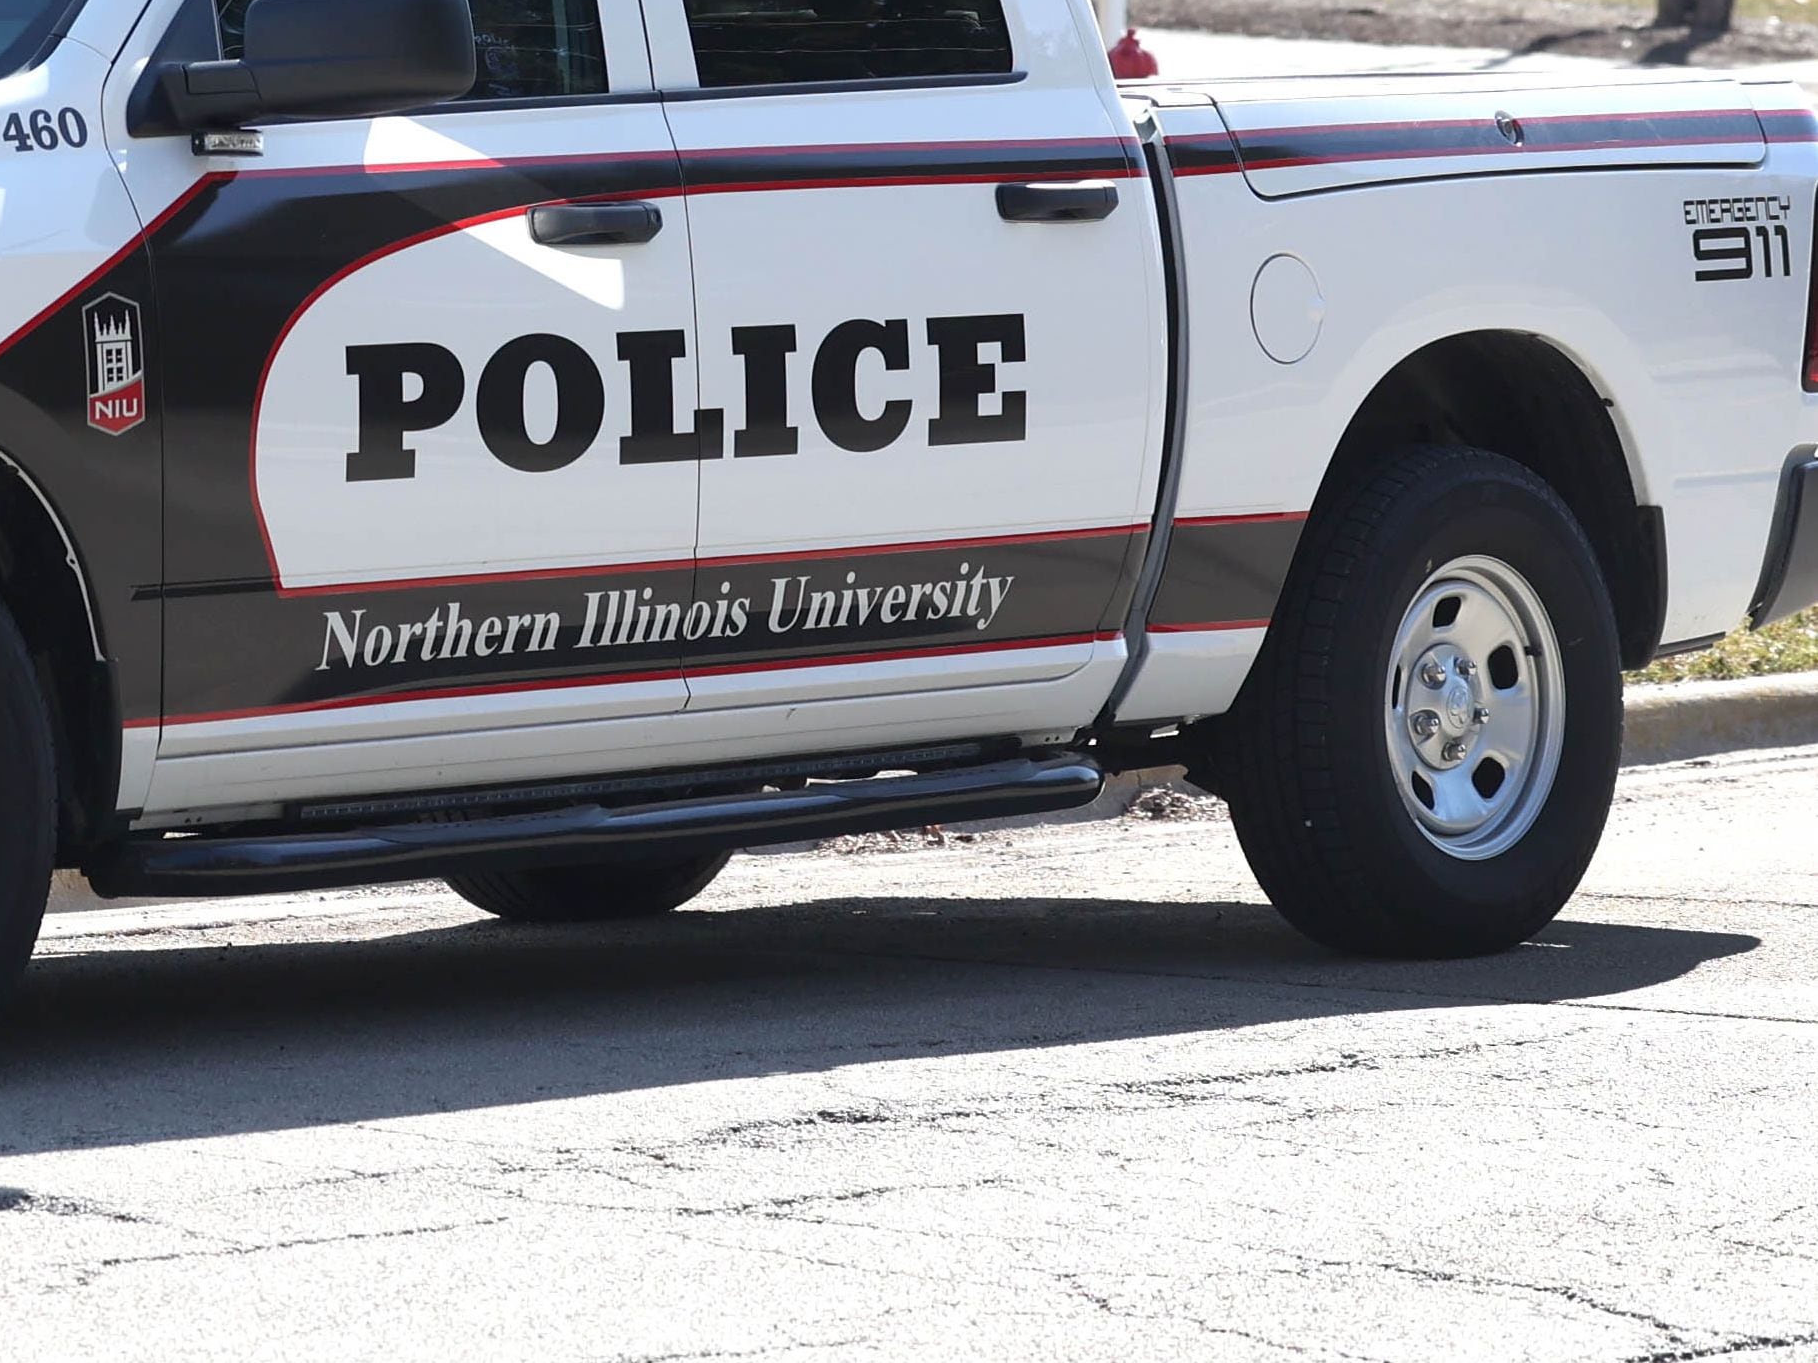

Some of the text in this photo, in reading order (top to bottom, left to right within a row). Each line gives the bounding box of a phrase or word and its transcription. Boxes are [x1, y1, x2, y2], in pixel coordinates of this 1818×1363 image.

[2, 107, 88, 153] 460
[1683, 196, 1791, 224] EMERGENCY
[1692, 225, 1791, 282] 911
[94, 398, 138, 420] NIU
[344, 313, 1028, 483] POLICE
[314, 562, 1014, 671] Northern Illinois University
